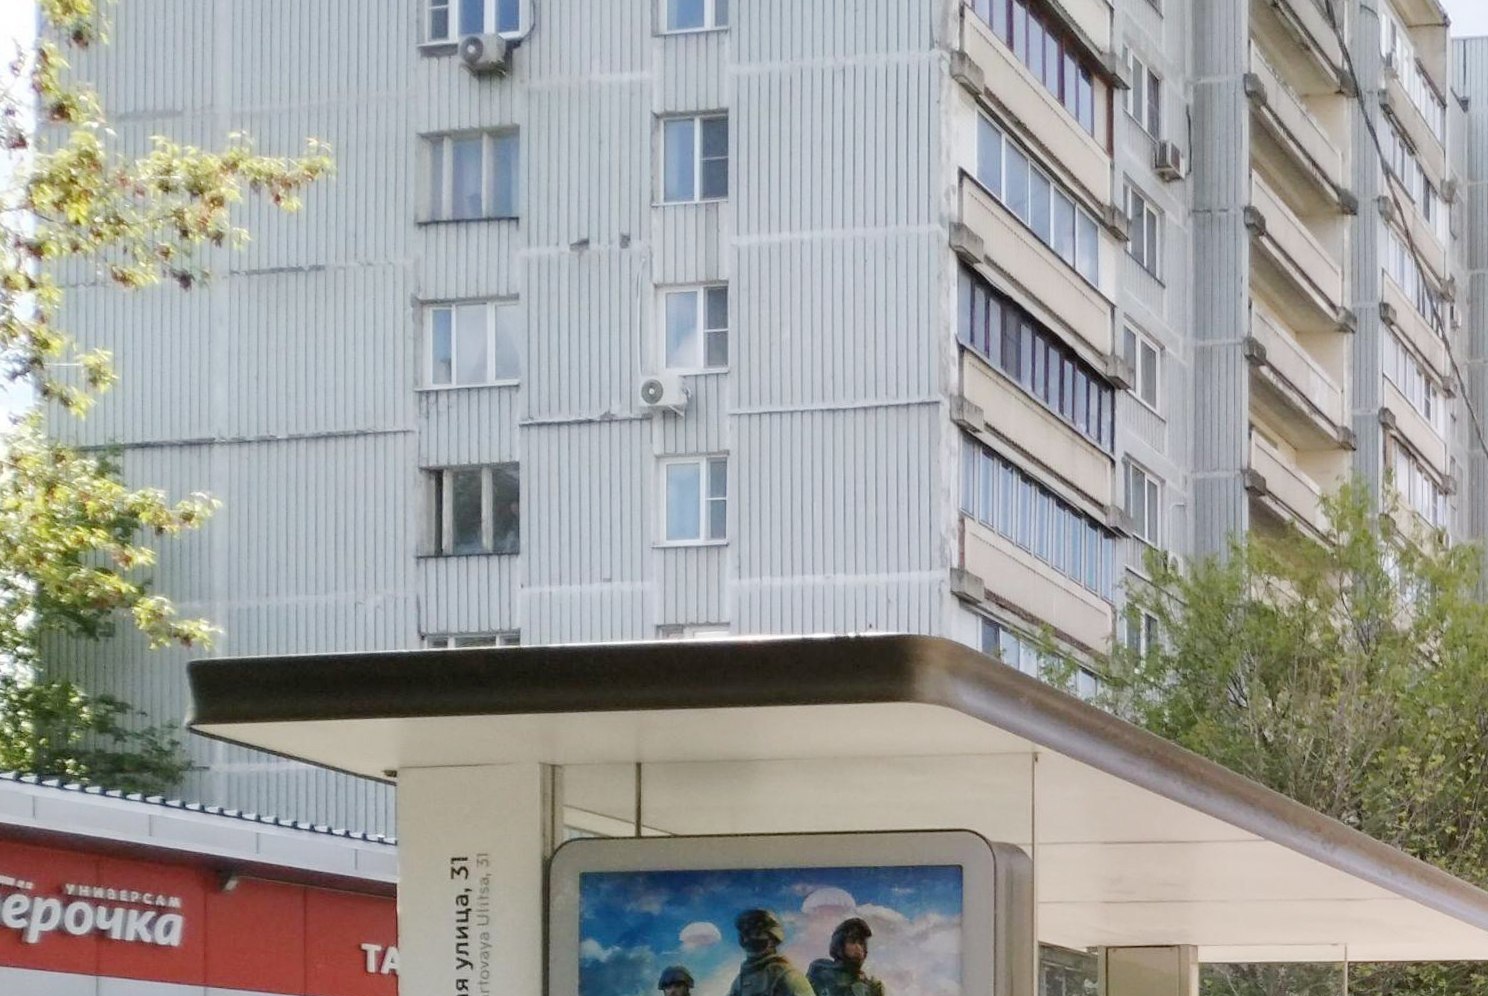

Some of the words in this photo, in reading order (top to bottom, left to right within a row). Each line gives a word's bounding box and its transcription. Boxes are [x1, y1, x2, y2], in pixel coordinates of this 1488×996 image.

[450, 856, 469, 880] 31
[476, 852, 489, 867] 31
[64, 883, 181, 908] УНИВЕРСАМ
[455, 886, 473, 970] улица,
